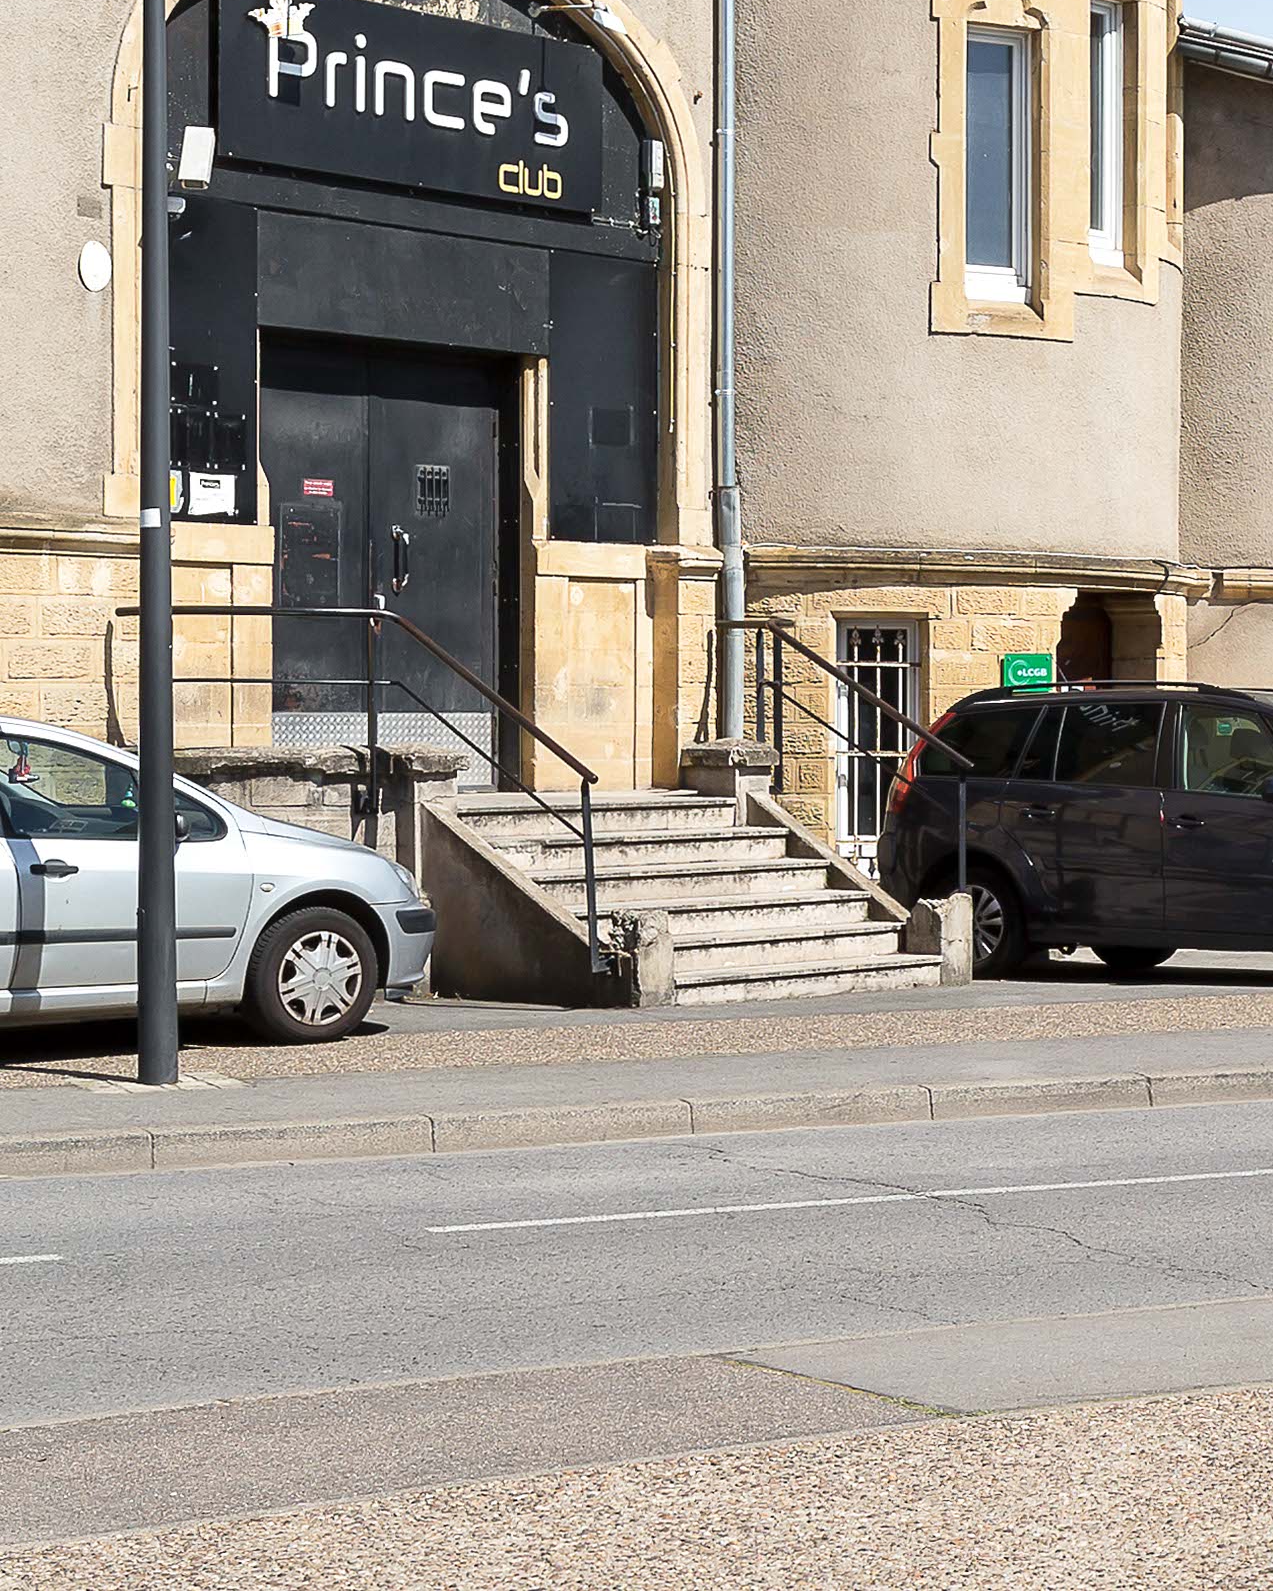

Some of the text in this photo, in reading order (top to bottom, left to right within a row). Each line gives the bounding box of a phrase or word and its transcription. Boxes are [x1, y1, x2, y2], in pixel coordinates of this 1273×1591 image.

[268, 29, 569, 148] Prince's
[498, 159, 563, 200] club
[1022, 668, 1048, 677] LCGB
